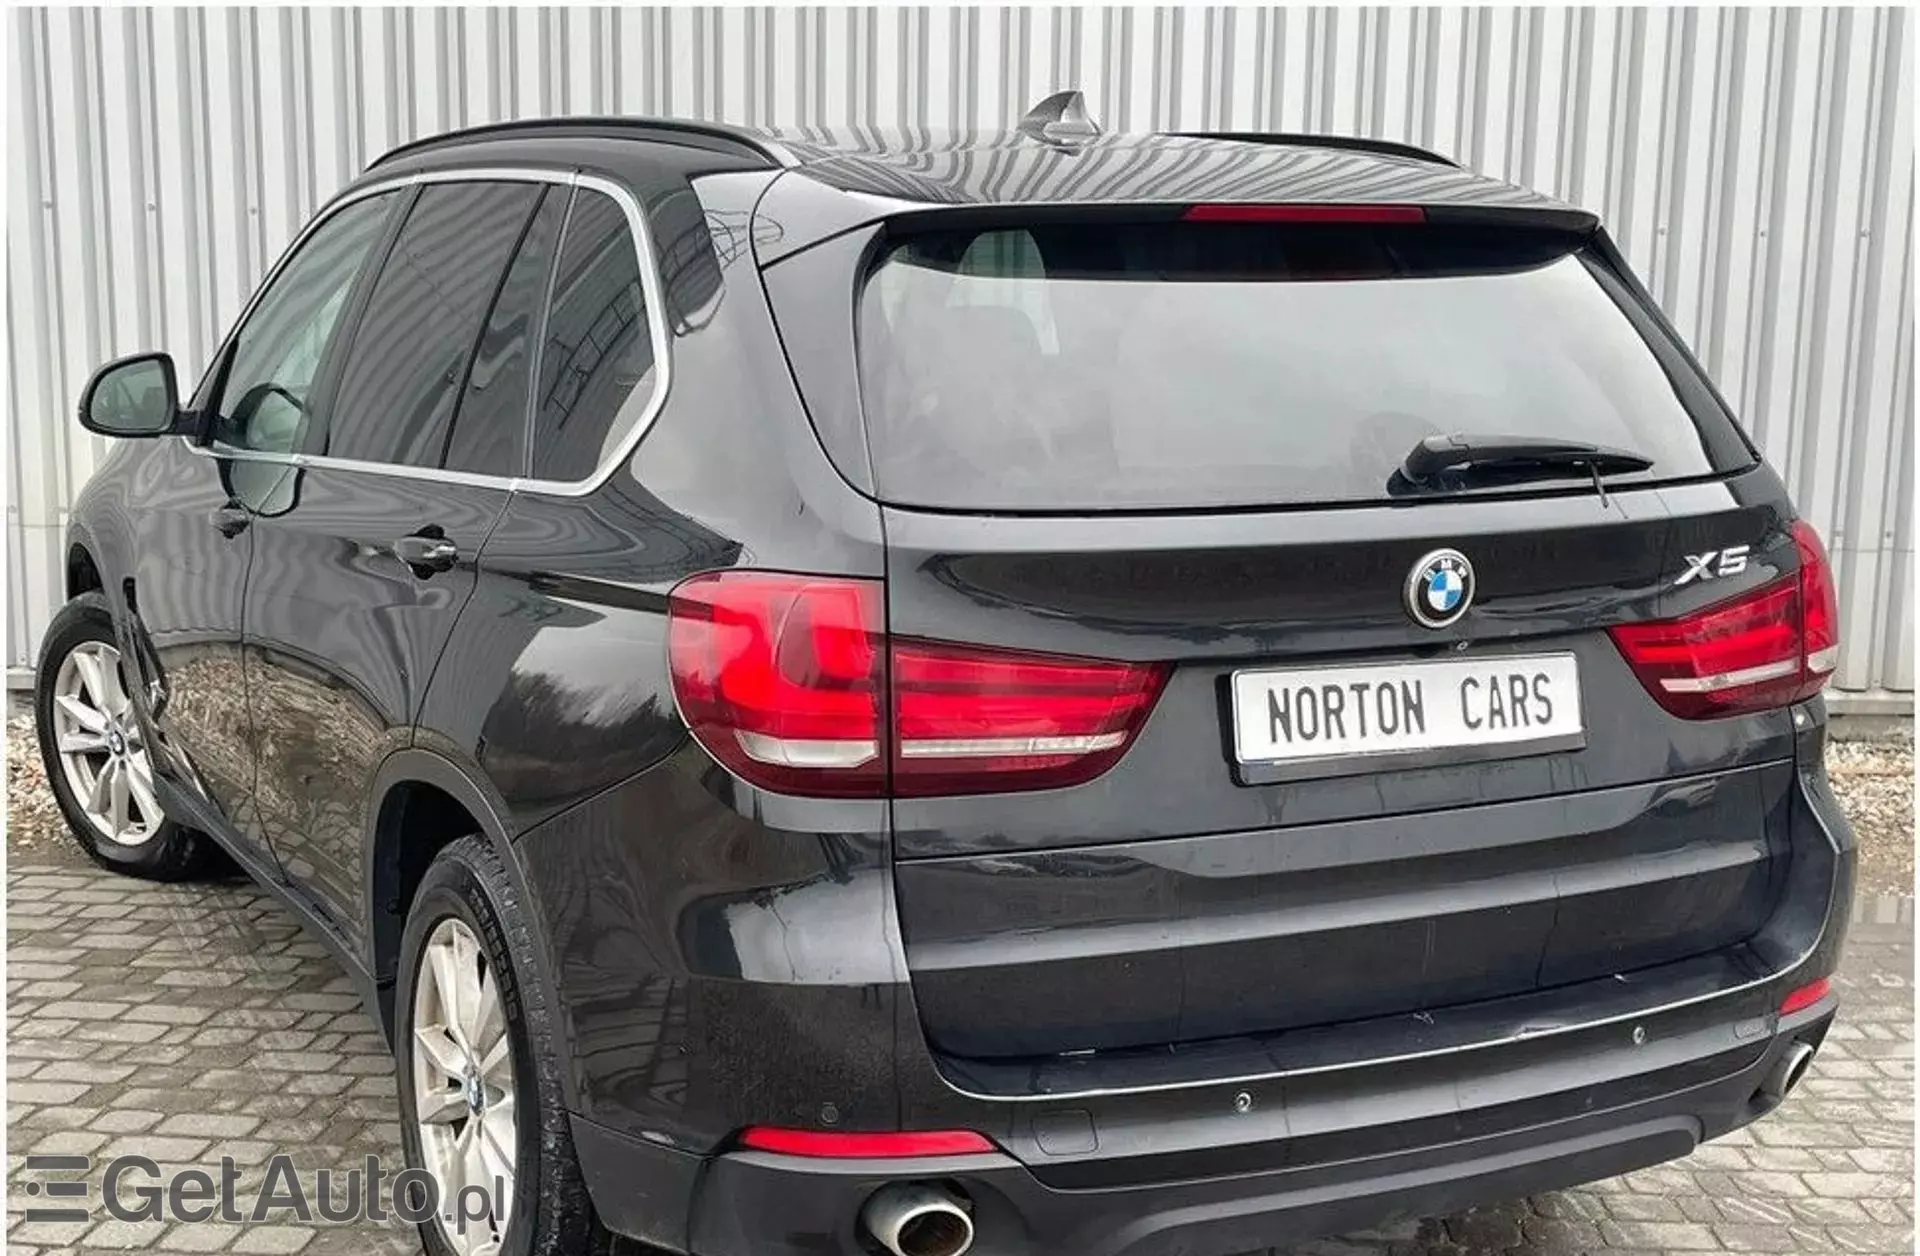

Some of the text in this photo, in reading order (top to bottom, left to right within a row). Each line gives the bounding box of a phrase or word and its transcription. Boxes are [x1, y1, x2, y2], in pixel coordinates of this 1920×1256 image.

[1422, 558, 1468, 581] BMW
[1673, 544, 1750, 585] X5
[1267, 673, 1553, 744] NORTON CARS
